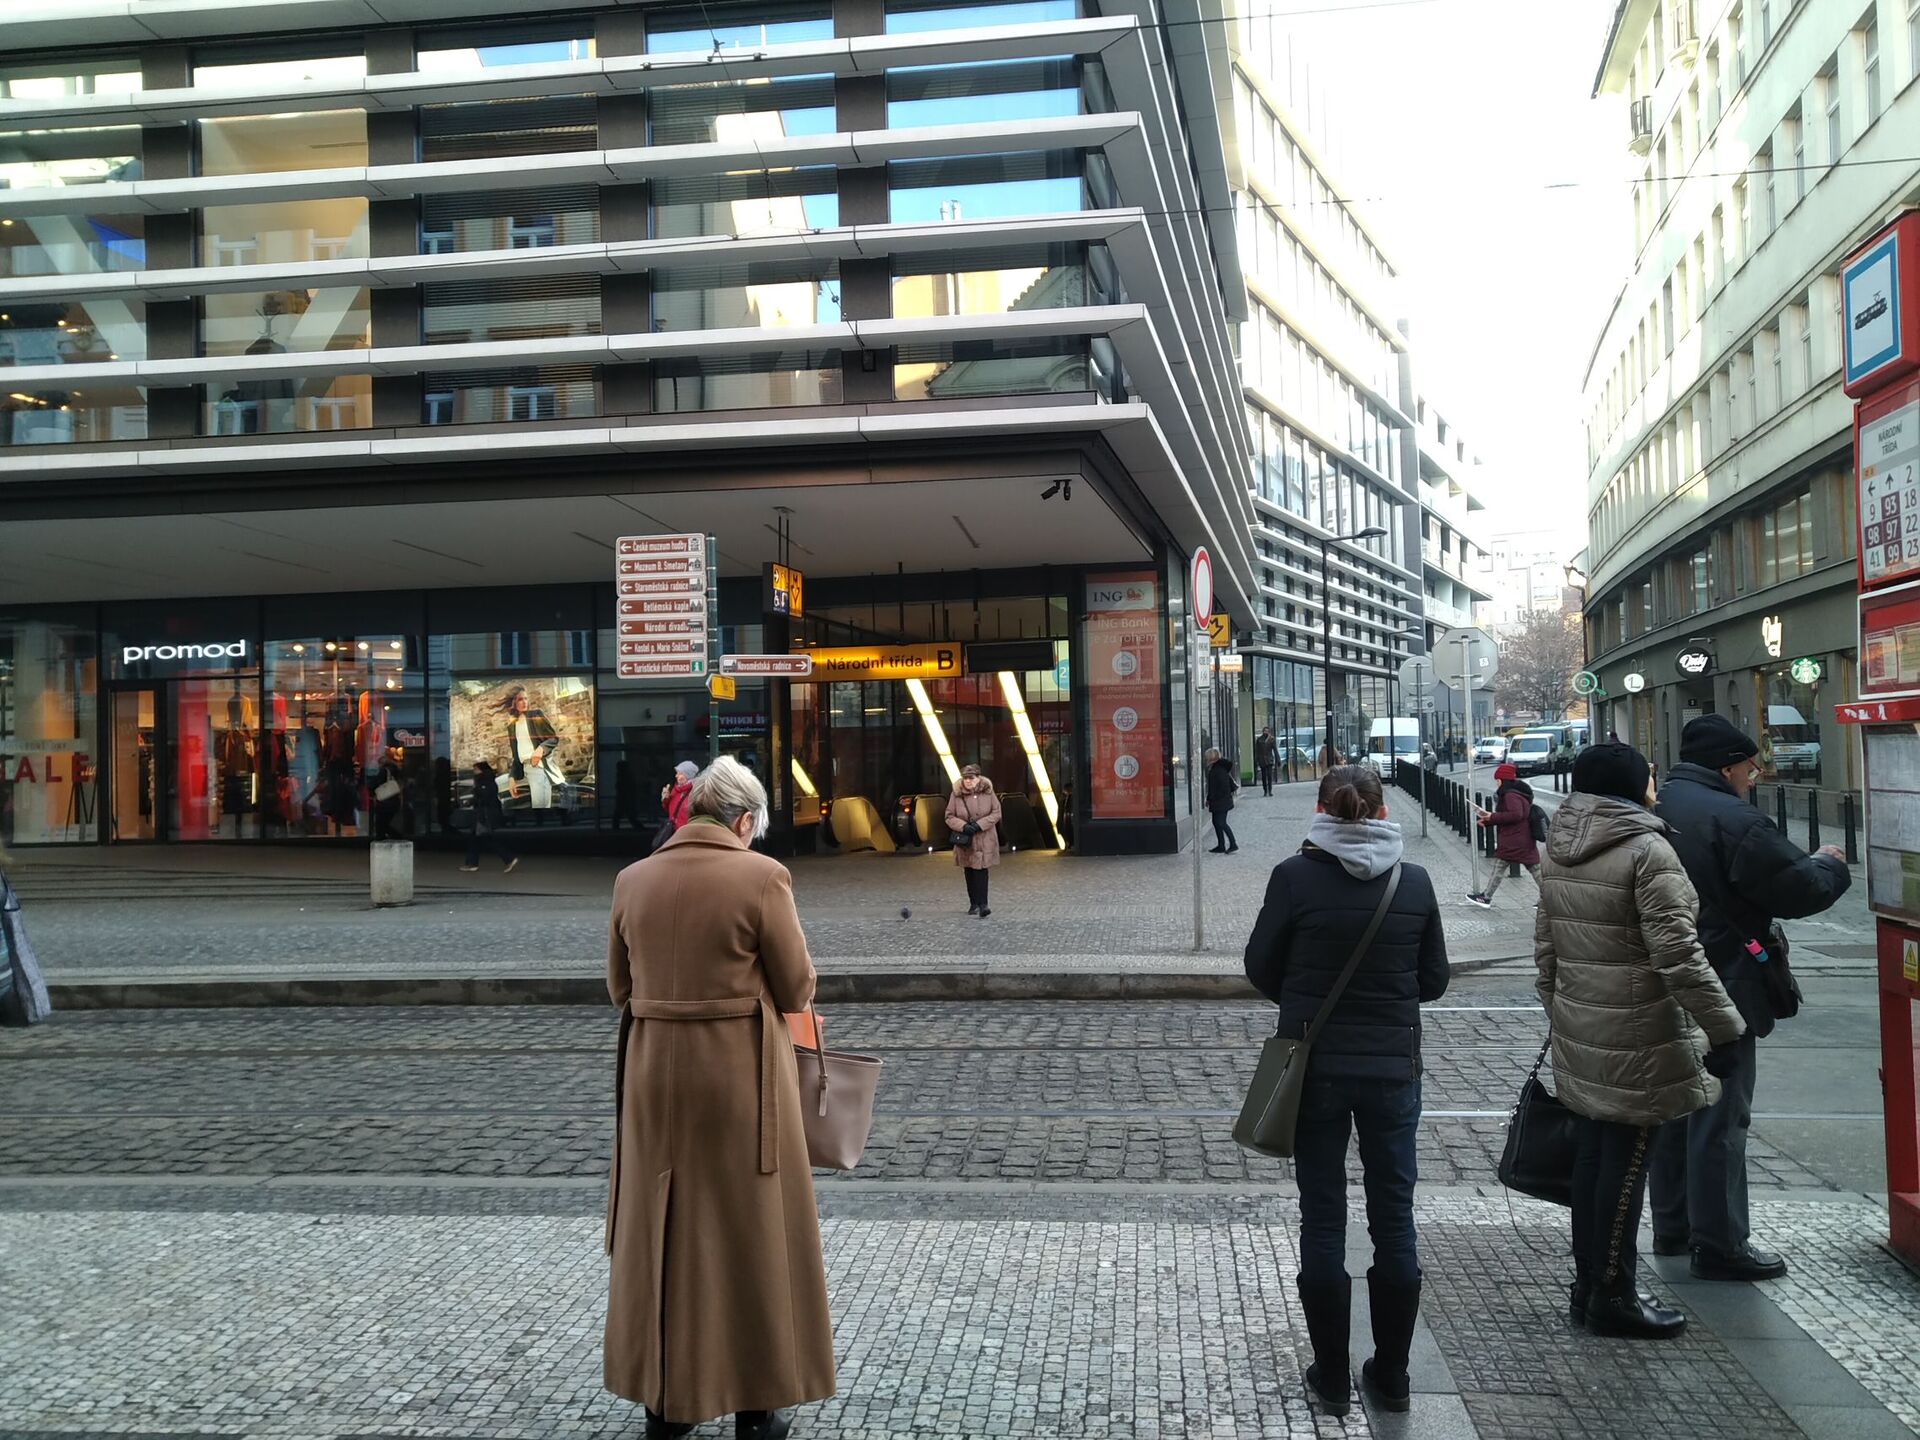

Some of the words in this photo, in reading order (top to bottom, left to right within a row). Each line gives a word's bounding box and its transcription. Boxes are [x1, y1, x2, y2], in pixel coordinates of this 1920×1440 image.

[1878, 421, 1902, 443] NÁRODNÍ
[1882, 441, 1898, 456] TŘÍDA
[1906, 465, 1912, 484] 2
[1885, 495, 1897, 516] 93
[1904, 488, 1918, 509] 18
[1870, 504, 1876, 520] 9
[1868, 526, 1880, 545] 98
[1886, 519, 1898, 539] 97
[1906, 514, 1918, 534] 22
[1870, 551, 1881, 568] 41
[1888, 545, 1900, 563] 99
[1906, 539, 1919, 558] 23
[1093, 590, 1123, 602] ING
[644, 622, 666, 632] Národní
[1098, 618, 1119, 629] ING
[1121, 617, 1150, 628] Bank
[123, 638, 246, 664] promod
[826, 655, 884, 671] Národní
[889, 655, 922, 668] třída
[937, 650, 954, 670] B
[772, 661, 792, 670] radnice
